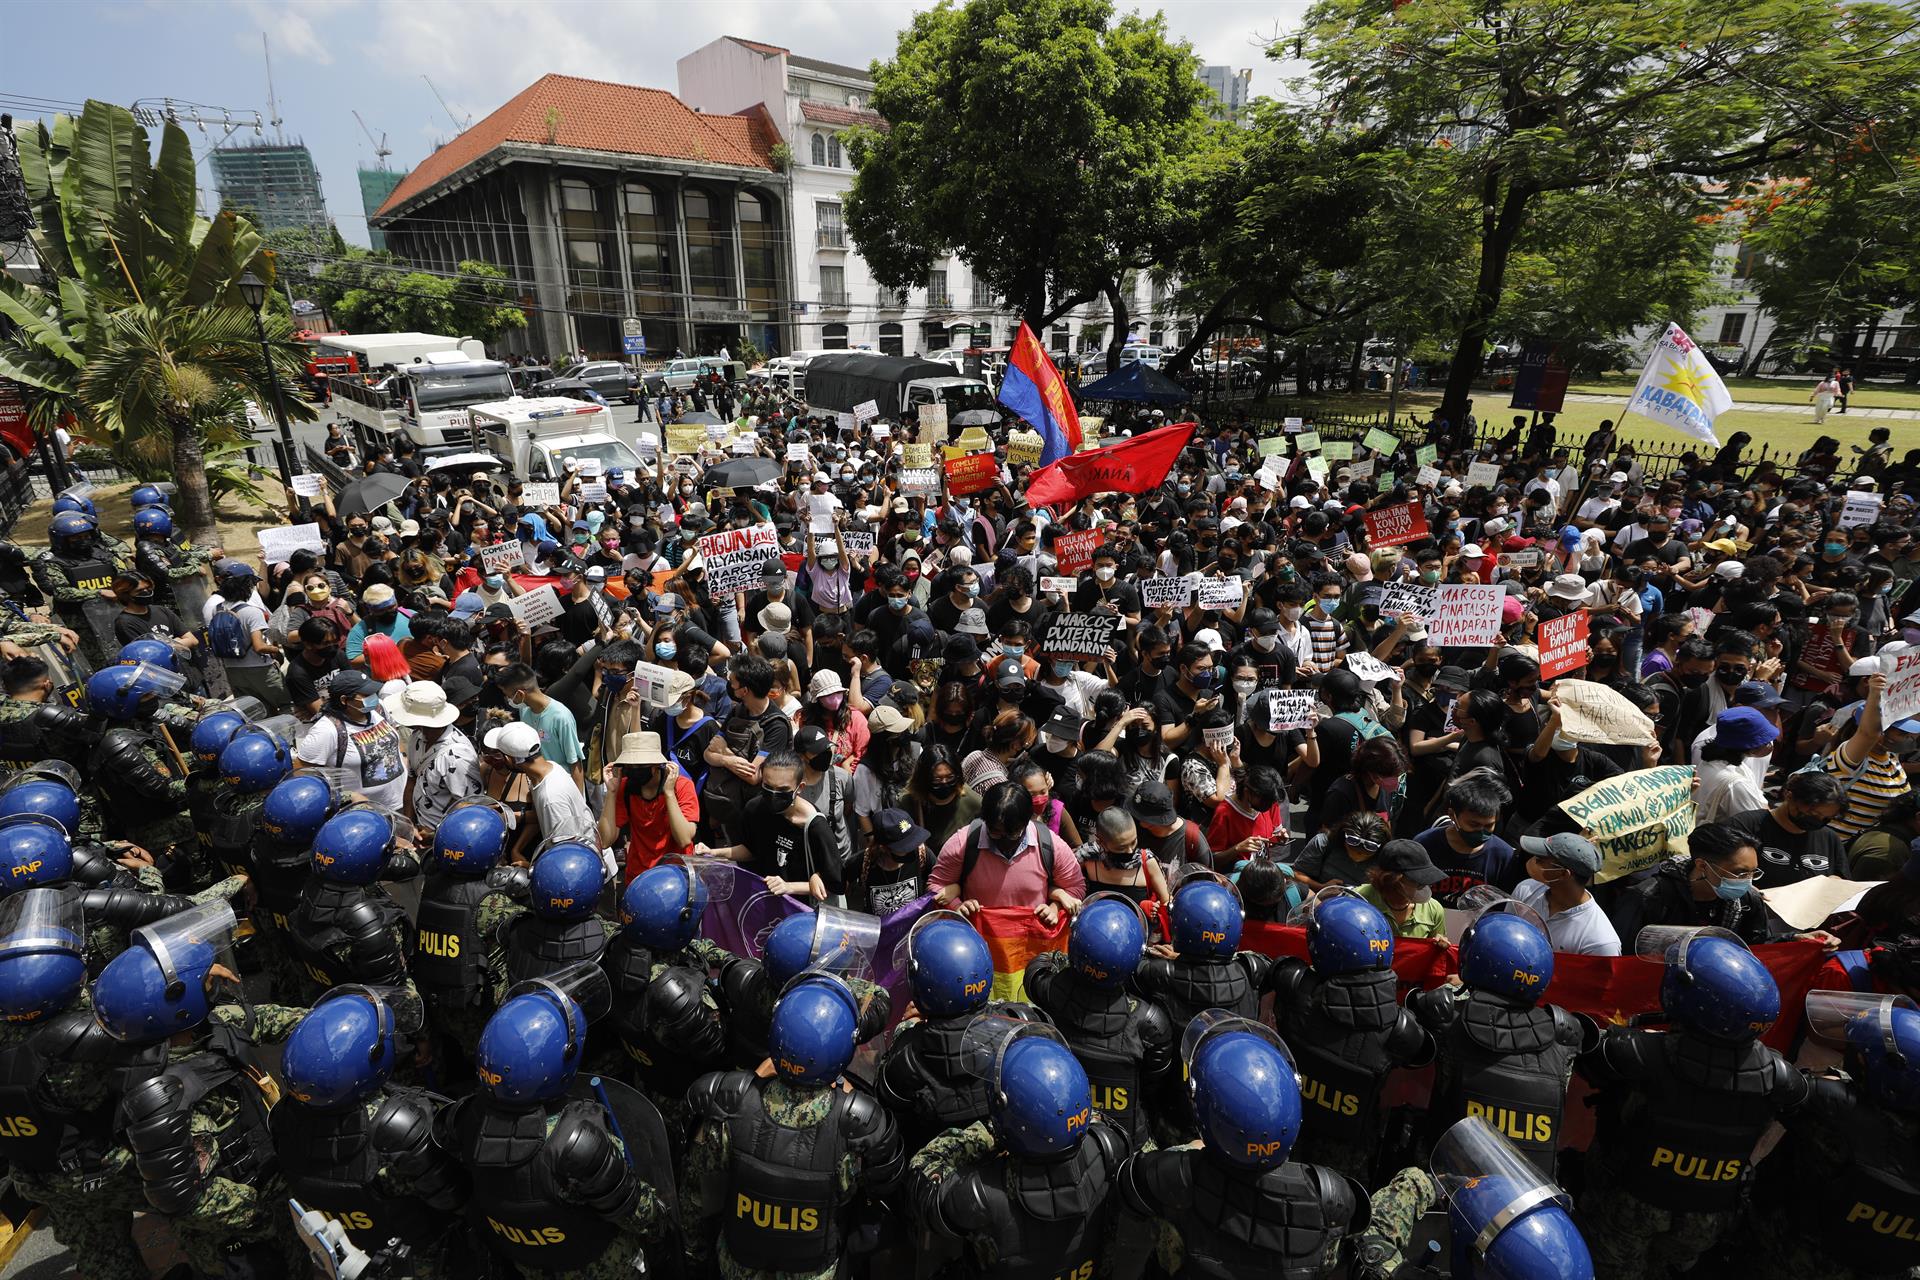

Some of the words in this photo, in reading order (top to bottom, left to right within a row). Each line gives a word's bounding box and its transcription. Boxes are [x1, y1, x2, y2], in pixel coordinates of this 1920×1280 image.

[1641, 385, 1712, 428] KABATAAN
[903, 469, 935, 477] MARCOS
[1373, 505, 1409, 521] KABATAAN
[1376, 516, 1412, 529] KONTRA
[1378, 524, 1411, 538] DAYA!
[701, 530, 752, 557] BIGUIN
[753, 530, 777, 546] ANG
[1058, 533, 1087, 546] TUTULAN
[1064, 539, 1096, 555] DAYAAN
[483, 541, 518, 556] COMELEC
[706, 547, 778, 571] ALYANSANG
[708, 563, 763, 582] MARCO
[1147, 586, 1186, 597] DUTERTE
[1441, 588, 1496, 602] MARCOS
[524, 598, 540, 607] PERO
[1380, 600, 1434, 618] PANAGUTIN!
[531, 606, 553, 616] INITIAL
[1440, 603, 1499, 619] PINATALSIK
[1056, 614, 1115, 632] MARCOS
[1432, 619, 1496, 634] DINADAPAT
[1543, 613, 1577, 638] ISKOLAR
[1047, 627, 1110, 643] DUTERTE
[1550, 630, 1575, 648] BAYAN
[1541, 646, 1567, 664] KONTRA
[1568, 639, 1587, 656] DAYA!
[198, 754, 217, 763] PNP
[223, 776, 242, 785] PNP
[1567, 784, 1625, 819] BIGUIN
[1622, 781, 1638, 799] ANG
[1600, 807, 1648, 836] ITAKWIL
[1645, 796, 1661, 820] ANG
[315, 852, 335, 866] PNP
[443, 849, 464, 860] PNP
[12, 860, 43, 878] PNP
[551, 898, 574, 909] PNP
[419, 929, 460, 958] PULIS
[1203, 931, 1226, 944] PNP
[1369, 939, 1391, 952] PNP
[1083, 964, 1109, 980] PNP
[1513, 970, 1540, 986] PNP
[965, 980, 987, 997] PNP
[7, 1010, 42, 1022] PNP
[780, 1058, 806, 1076] PNP
[479, 1067, 502, 1086] PNP
[1091, 1085, 1129, 1111] LIS
[1301, 1074, 1360, 1116] ULIS
[1066, 1107, 1090, 1133] PNP
[1247, 1142, 1281, 1158] PNP
[1652, 1146, 1740, 1181] PULIS
[736, 1193, 819, 1232] PULIS
[487, 1215, 567, 1246] PULIS
